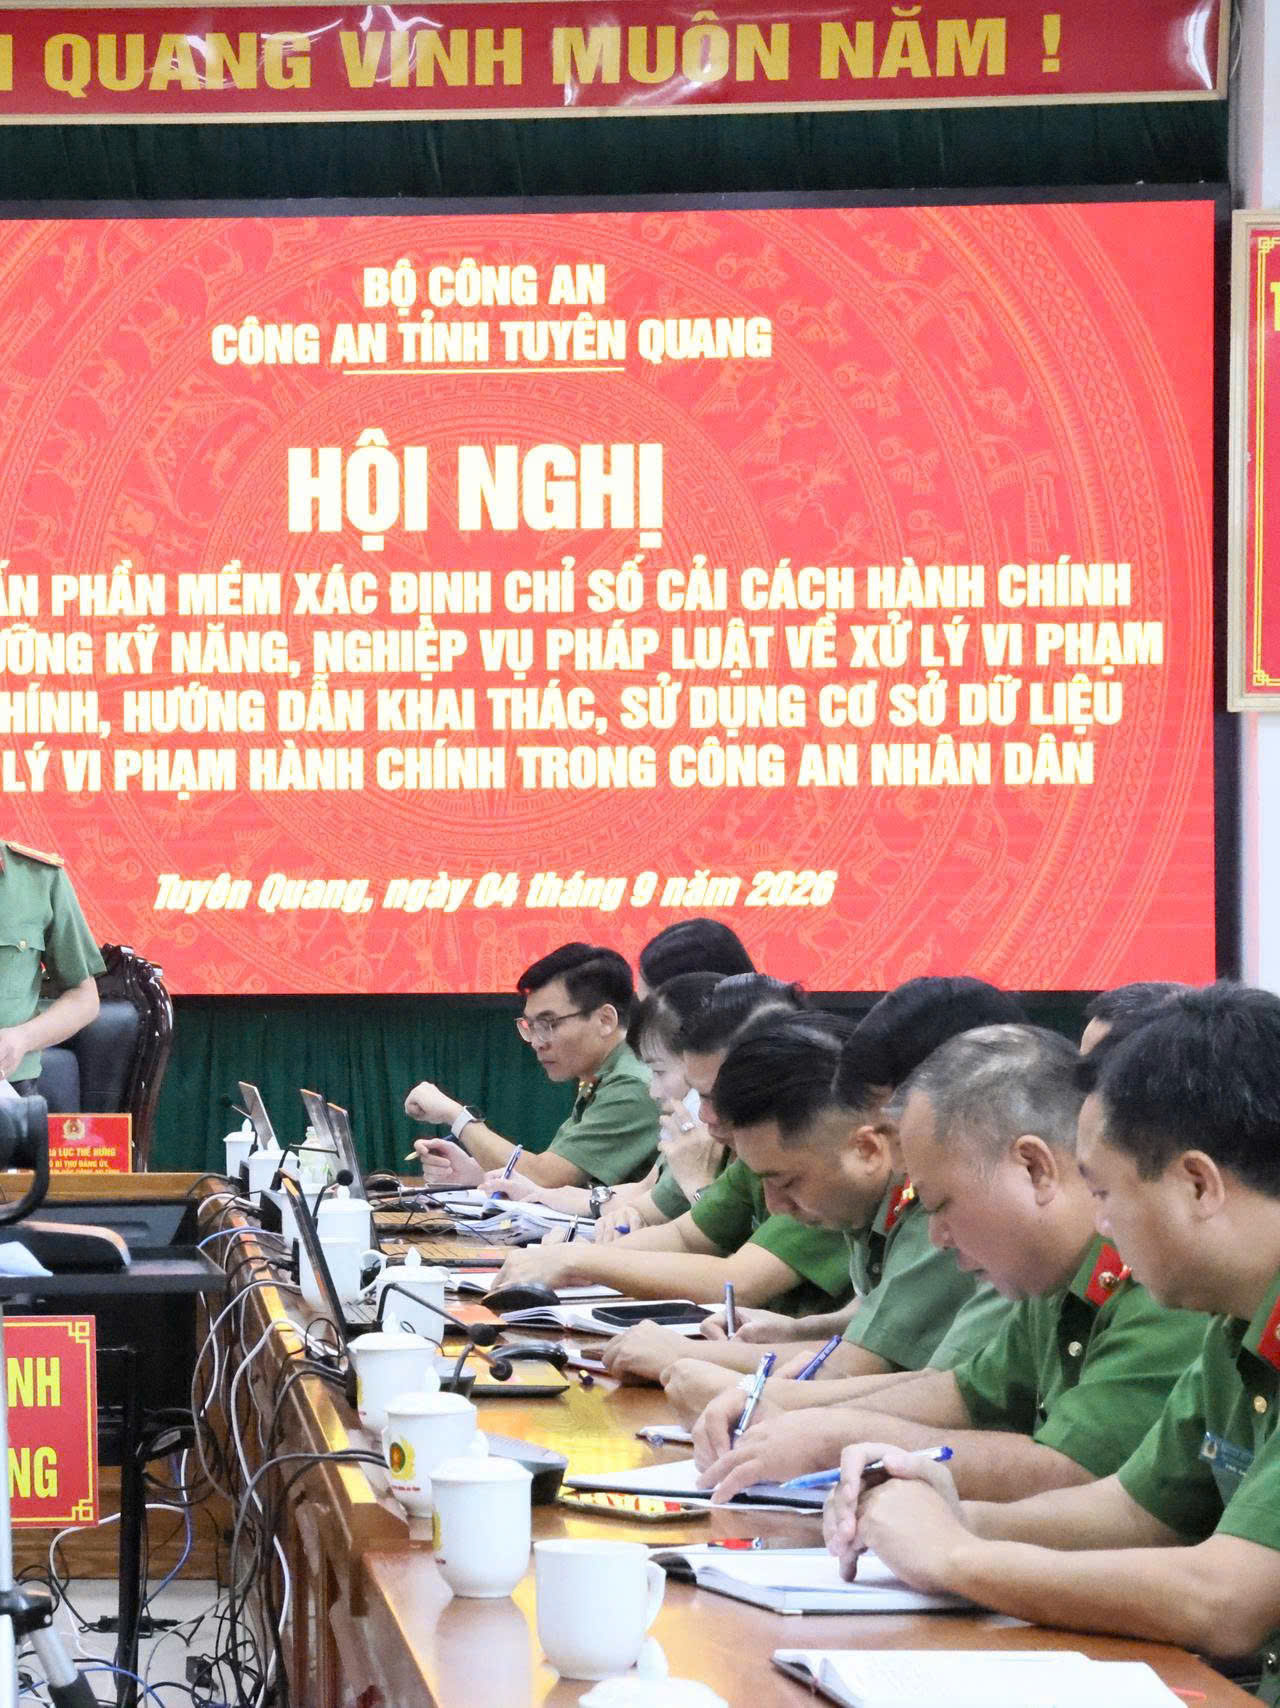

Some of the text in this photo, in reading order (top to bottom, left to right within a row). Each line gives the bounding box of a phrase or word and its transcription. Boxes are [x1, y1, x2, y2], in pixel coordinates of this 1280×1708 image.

[44, 32, 312, 97] QUANG
[339, 28, 523, 89] VINH
[552, 11, 790, 85] MUÔN
[820, 6, 1006, 80] NĂM
[1042, 14, 1061, 73] !
[363, 257, 606, 317] BỘ CÔNG AN
[211, 309, 773, 366] CÔNG AN TỈNH TUYÊN QUANG
[287, 427, 664, 552] HỘI NGHỊ
[51, 559, 166, 617] PHẦN
[178, 559, 282, 616] MỀM
[293, 563, 378, 615] XÁC
[388, 571, 492, 623] ĐỊNH
[504, 555, 576, 614] CHỈ
[587, 553, 646, 613] SỐ
[656, 553, 728, 612] CẢI
[740, 558, 855, 611] CÁCH
[867, 556, 985, 609] HÀNH
[997, 554, 1132, 608] CHÍNH
[105, 623, 160, 675] KỸ
[171, 622, 301, 679] NĂNG,
[312, 617, 468, 682] NGHIỆP
[479, 628, 534, 681] VỤ
[546, 618, 660, 671] PHÁP
[671, 617, 775, 679] LUẬT
[784, 611, 838, 669] VỀ
[849, 610, 913, 669] XỬ
[920, 614, 970, 667] LÝ
[981, 623, 1023, 667] VI
[1035, 621, 1164, 675] PHẠM
[123, 681, 266, 734] HƯỚNG
[277, 672, 365, 733] DẪN
[376, 687, 476, 732] KHAI
[486, 678, 608, 735] THÁC,
[619, 671, 683, 730] SỬ
[689, 684, 807, 738] DỤNG
[818, 679, 878, 729] CƠ
[888, 669, 948, 728] SỞ
[959, 673, 1022, 727] DỮ
[1029, 673, 1123, 735] LIỆU
[2, 741, 51, 793] LÝ
[61, 749, 102, 793] VI
[113, 748, 237, 801] PHẠM
[248, 738, 365, 791] HÀNH
[376, 738, 507, 791] CHÍNH
[516, 744, 657, 790] TRONG
[668, 735, 786, 788] CÔNG
[797, 743, 859, 787] AN
[870, 733, 992, 787] NHÂN
[1004, 732, 1095, 785] DÂN
[153, 872, 253, 915] Tuyên
[257, 872, 374, 914] Quang,
[382, 871, 473, 913] ngày
[472, 871, 520, 909] 04
[525, 870, 628, 912] tháng
[629, 870, 659, 908] 9
[659, 868, 743, 908] năm
